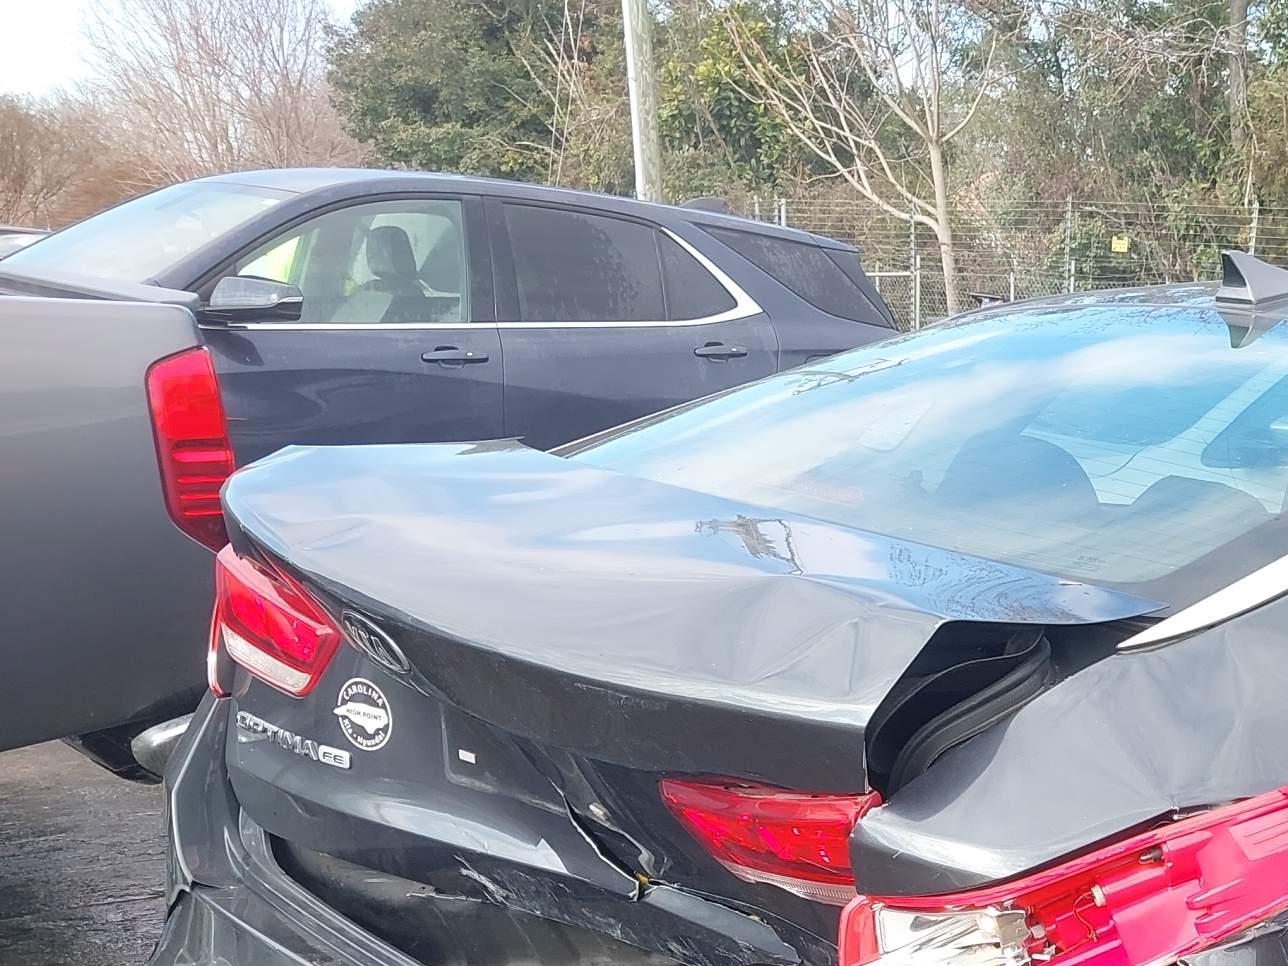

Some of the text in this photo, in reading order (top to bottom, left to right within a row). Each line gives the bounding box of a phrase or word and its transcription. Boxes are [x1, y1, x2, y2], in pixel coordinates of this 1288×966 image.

[343, 684, 383, 707] CAROLINA
[362, 711, 382, 721] POINT
[236, 711, 319, 761] OPTIMA
